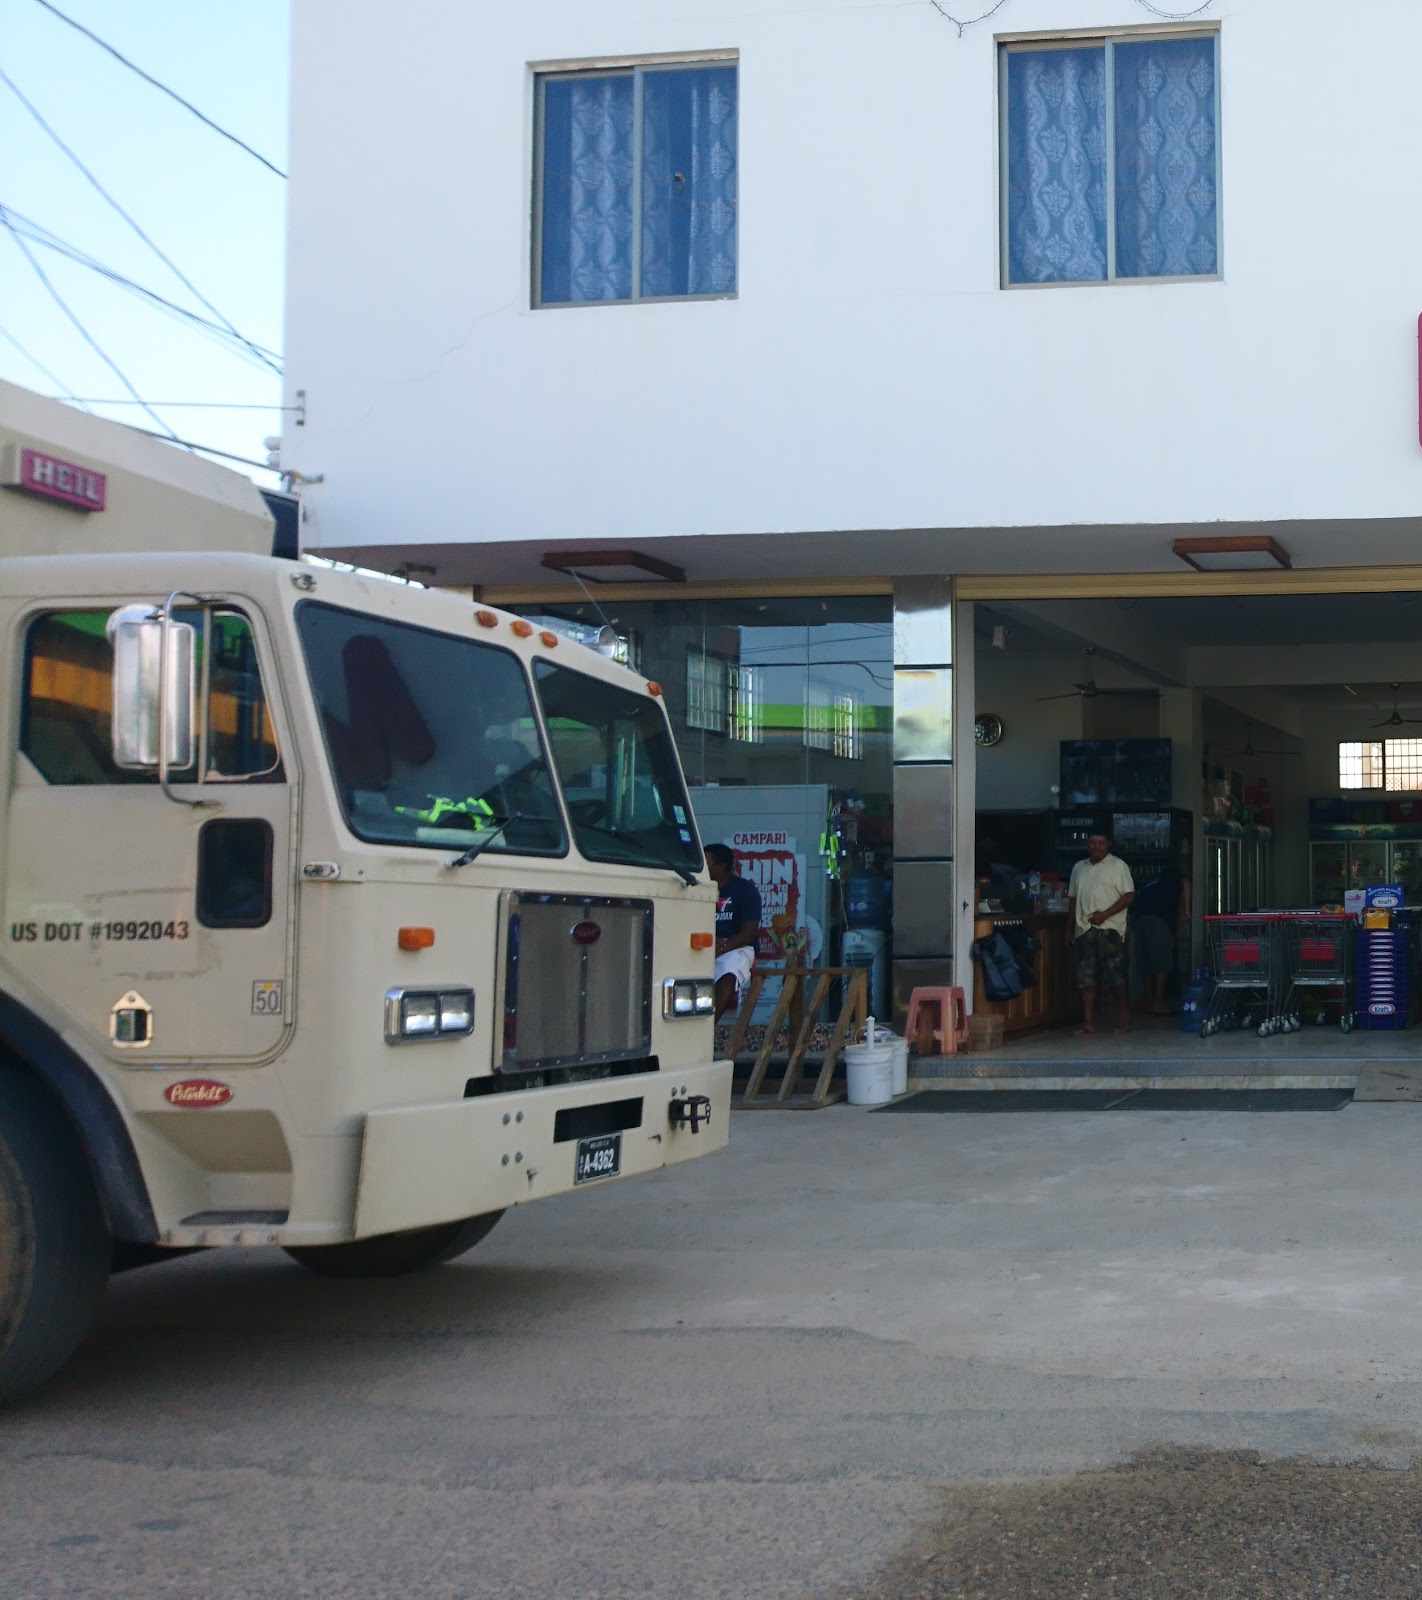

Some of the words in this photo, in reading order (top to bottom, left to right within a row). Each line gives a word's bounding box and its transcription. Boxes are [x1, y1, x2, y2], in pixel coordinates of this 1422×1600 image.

[33, 457, 101, 502] HEIL
[733, 833, 787, 845] CAMPARI
[11, 922, 38, 942] US
[44, 921, 83, 942] DOT
[89, 920, 190, 941] #1992043
[255, 990, 279, 1011] 50
[170, 1084, 227, 1102] Peterbilt
